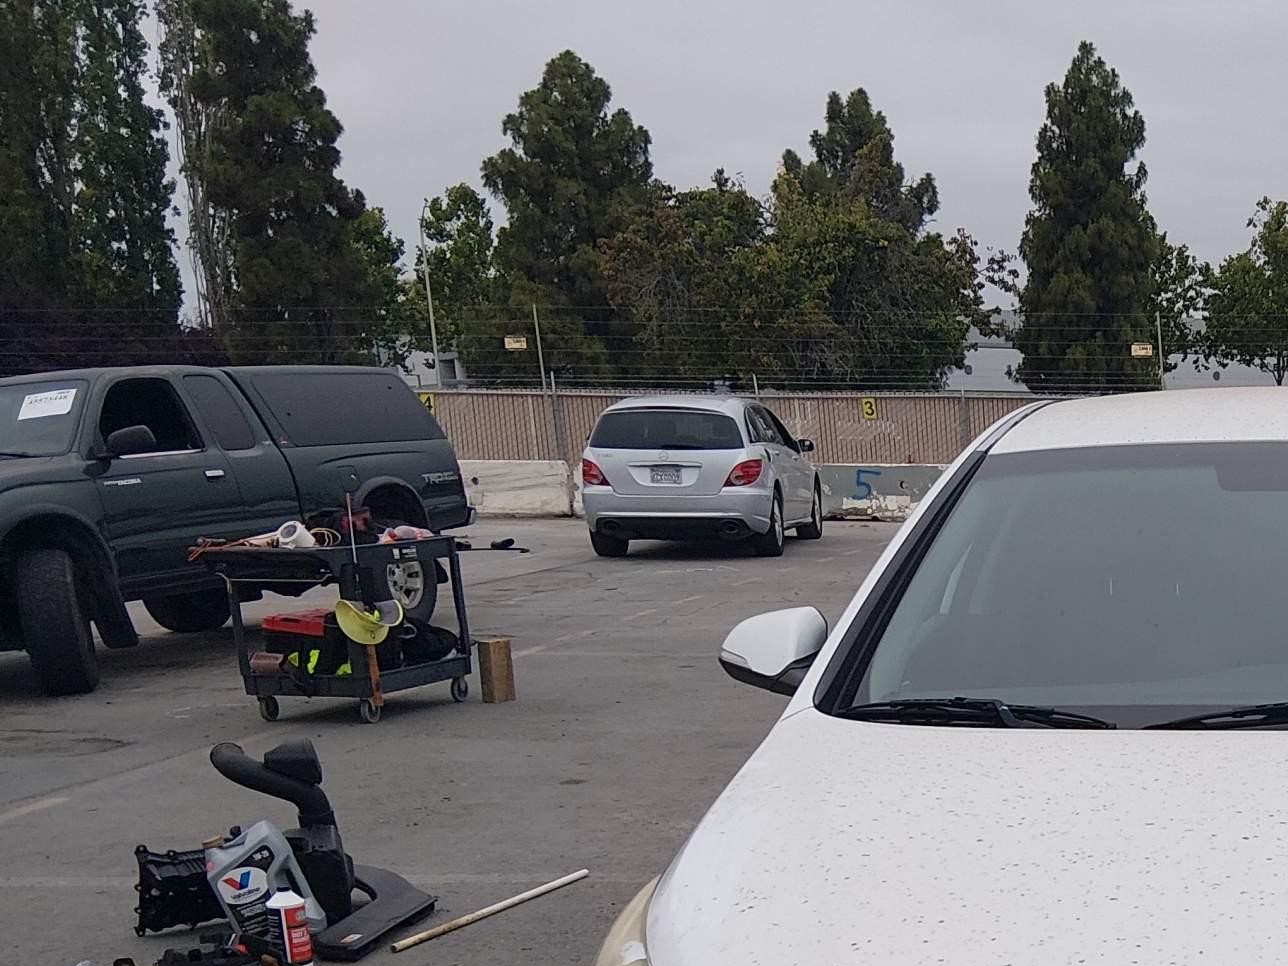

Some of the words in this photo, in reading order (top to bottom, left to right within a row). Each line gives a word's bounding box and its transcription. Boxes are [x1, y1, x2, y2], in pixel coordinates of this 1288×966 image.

[423, 395, 433, 411] 4
[864, 400, 875, 416] 3
[852, 469, 882, 499] 5
